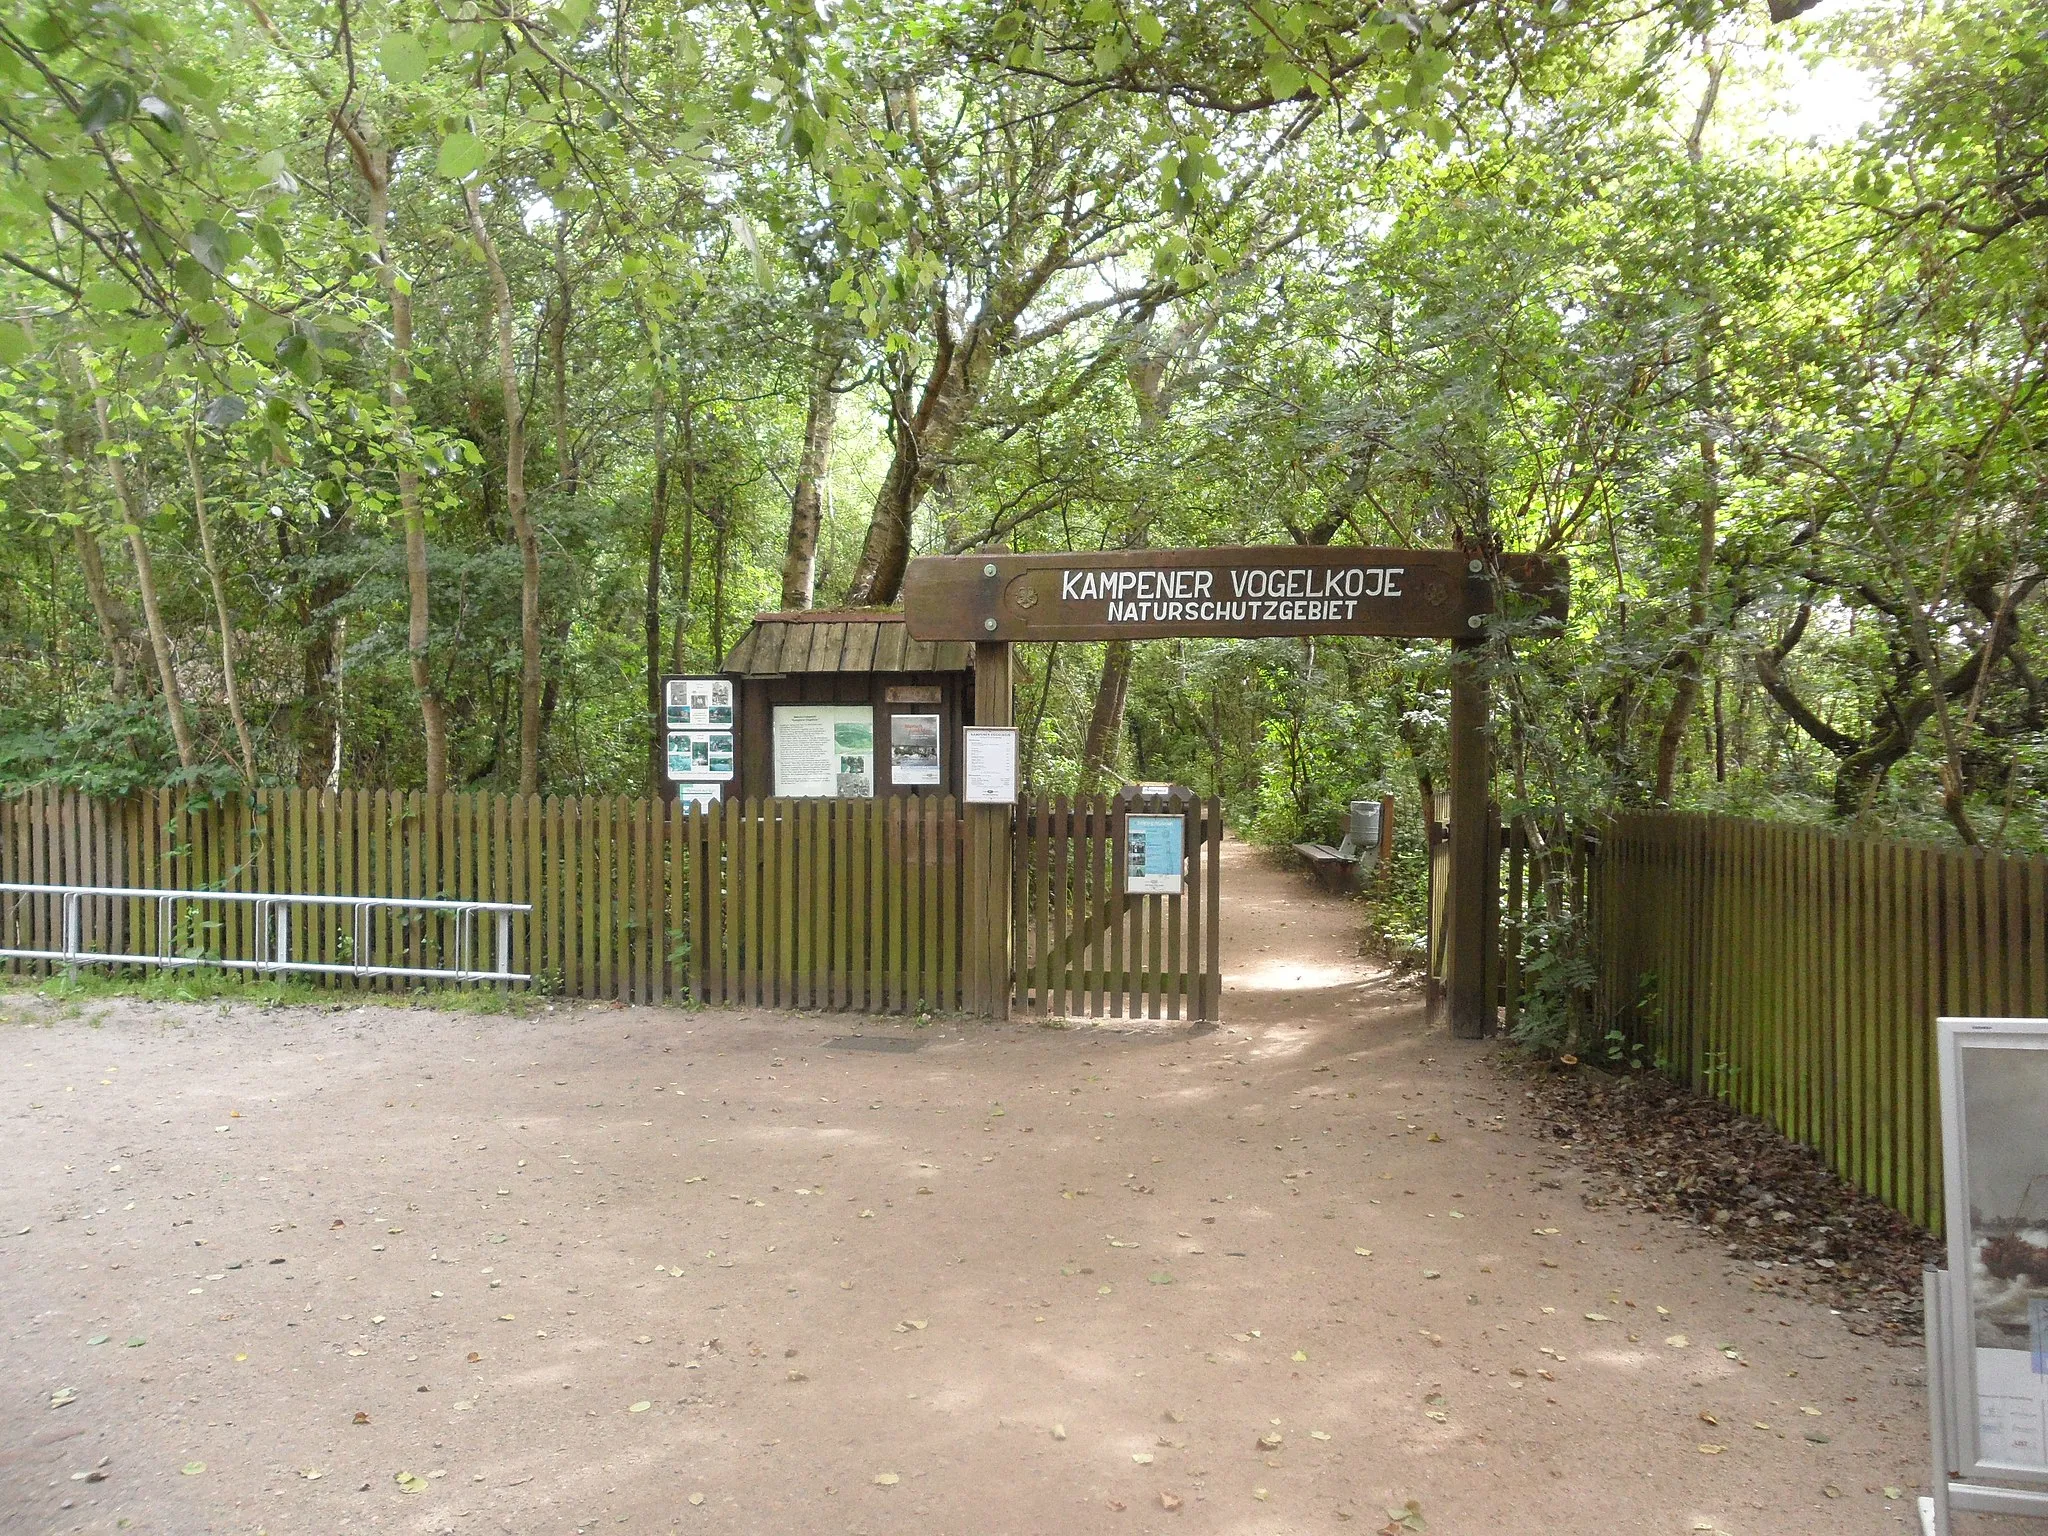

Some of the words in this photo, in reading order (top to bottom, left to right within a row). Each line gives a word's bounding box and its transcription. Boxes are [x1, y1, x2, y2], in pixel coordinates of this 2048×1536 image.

[1062, 570, 1214, 599] KAMPENER
[1230, 568, 1405, 598] VOGELKOJE
[1107, 600, 1358, 622] NATURSCHUTZGEBIET
